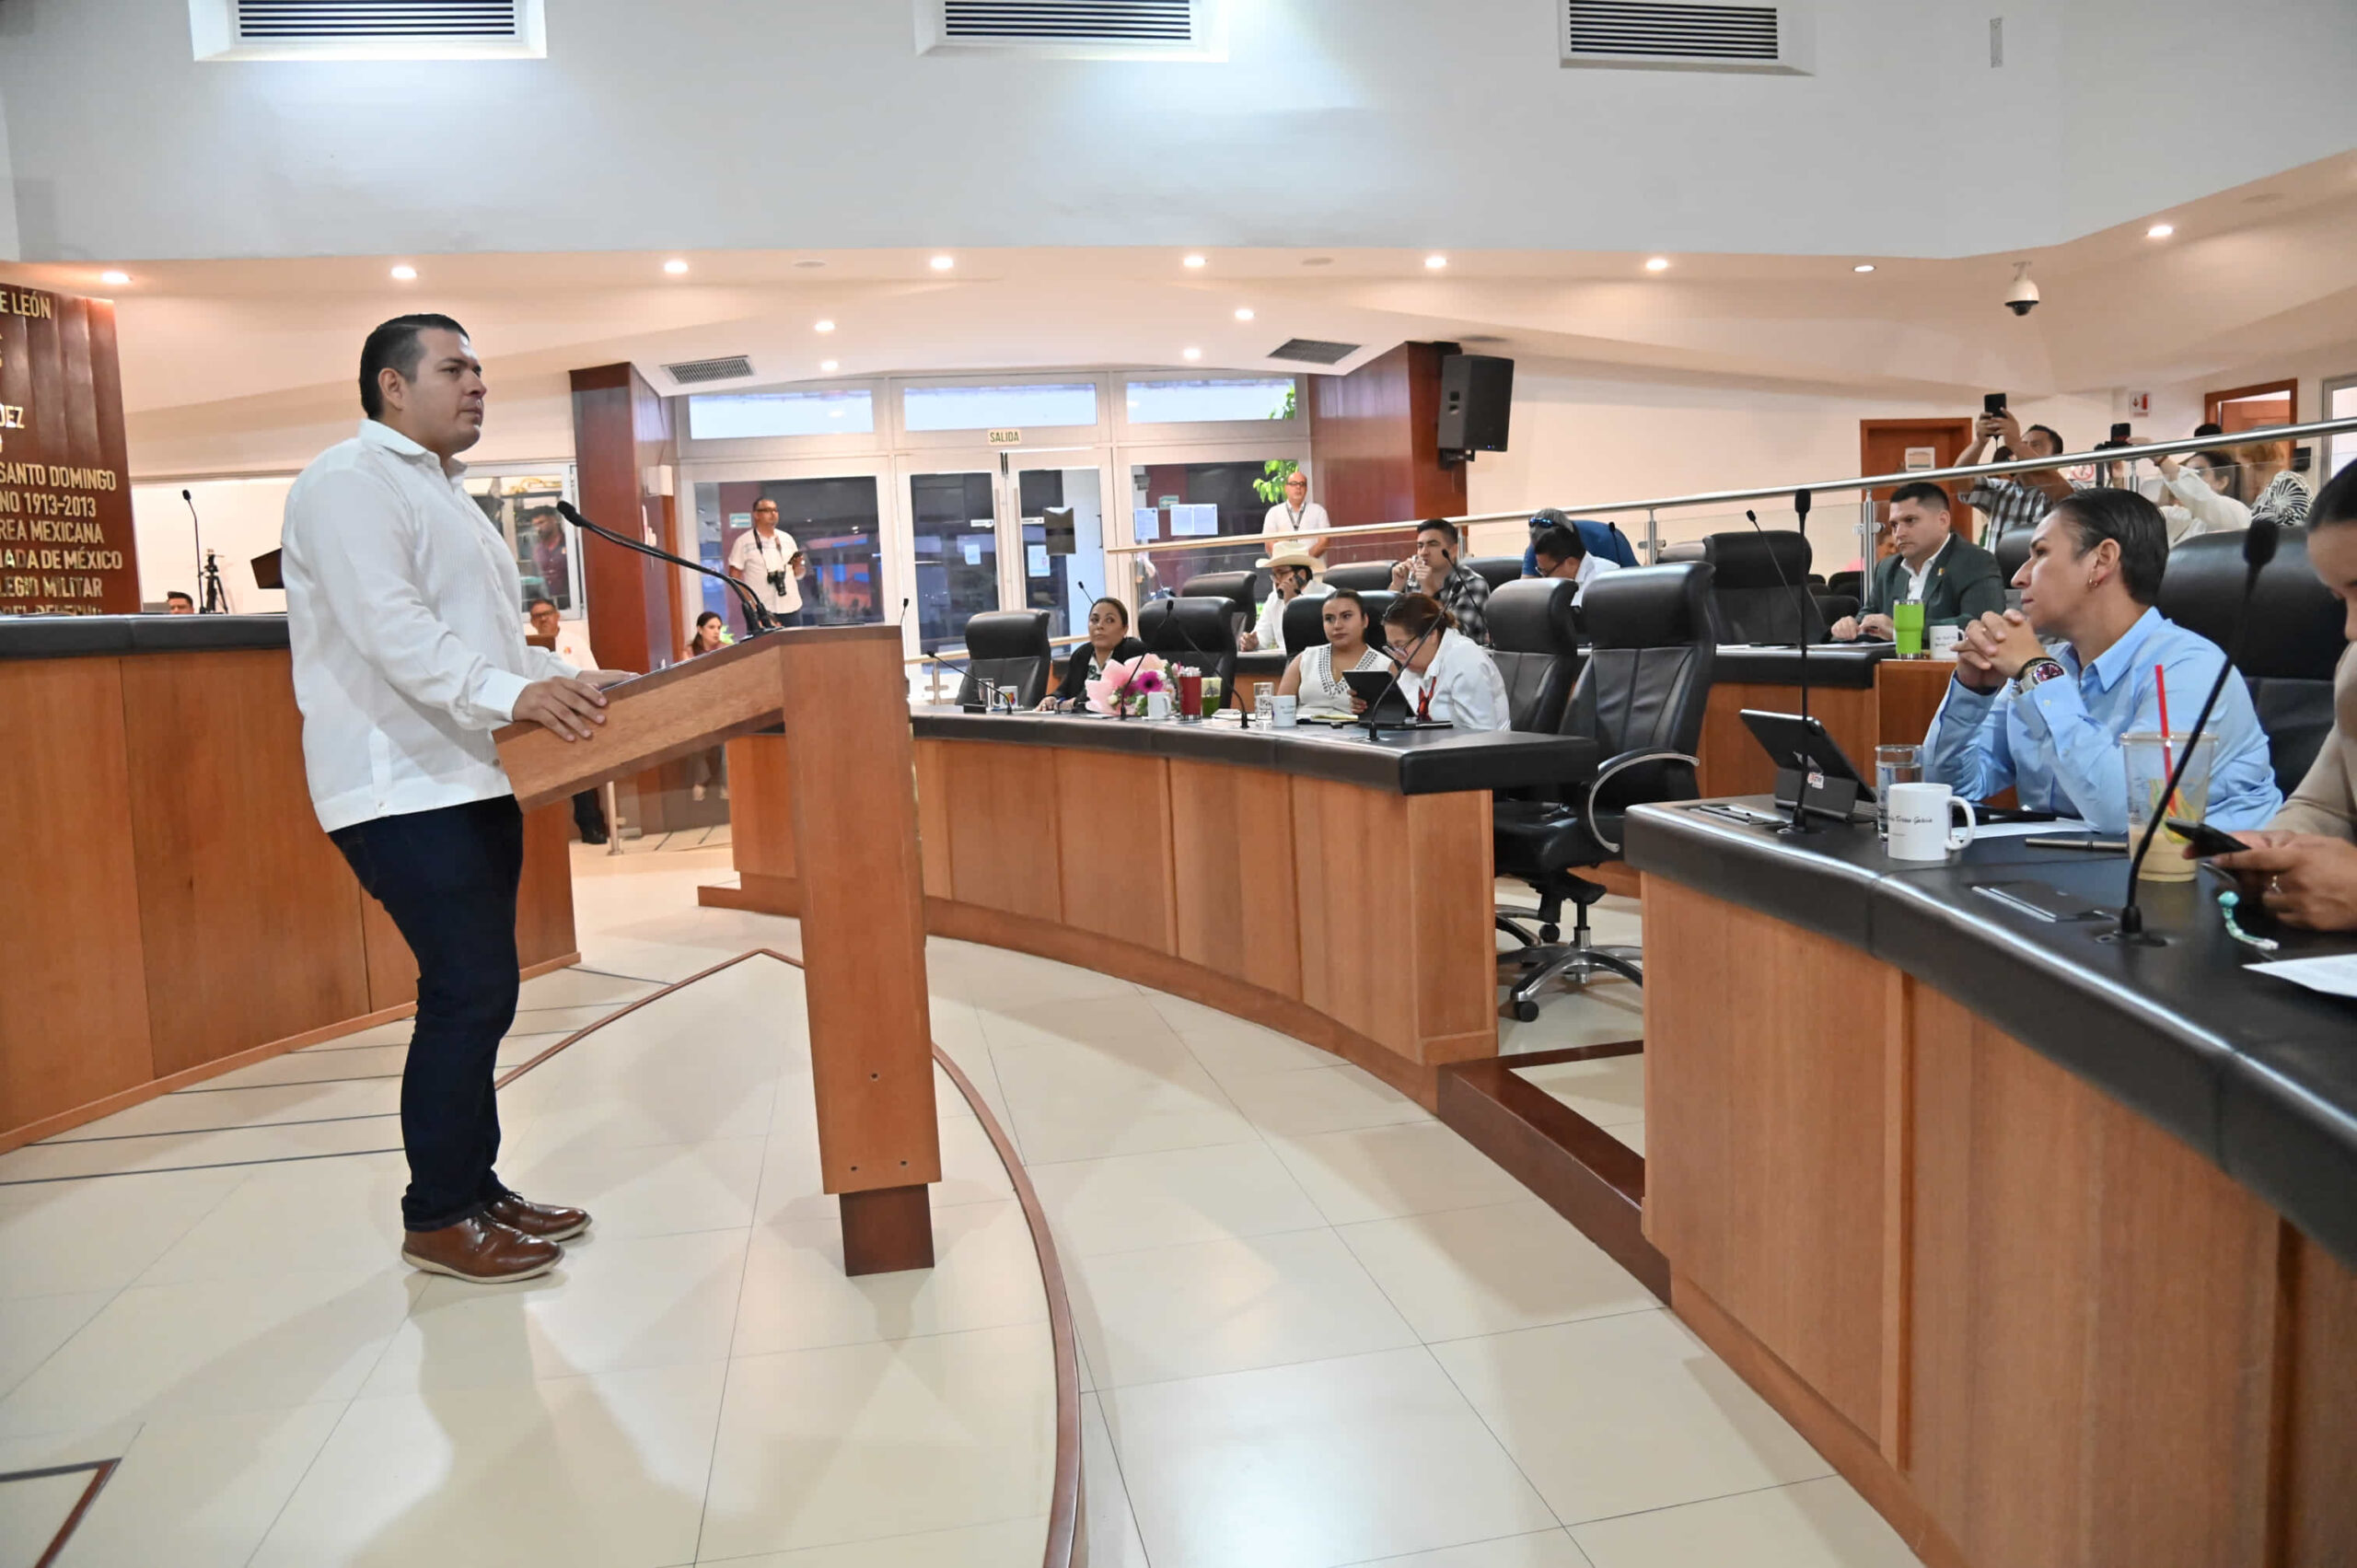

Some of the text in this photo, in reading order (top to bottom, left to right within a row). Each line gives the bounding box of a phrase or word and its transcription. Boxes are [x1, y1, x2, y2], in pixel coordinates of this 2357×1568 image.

[12, 291, 52, 319] LEÓN
[989, 431, 1019, 443] SALIDA
[0, 461, 117, 492] SANTO DOMINGO
[24, 492, 97, 517] 1913-2013
[29, 519, 105, 544] MEXICANA
[0, 546, 123, 570] ADA DE MÉXICO
[42, 575, 103, 598] MILITAR
